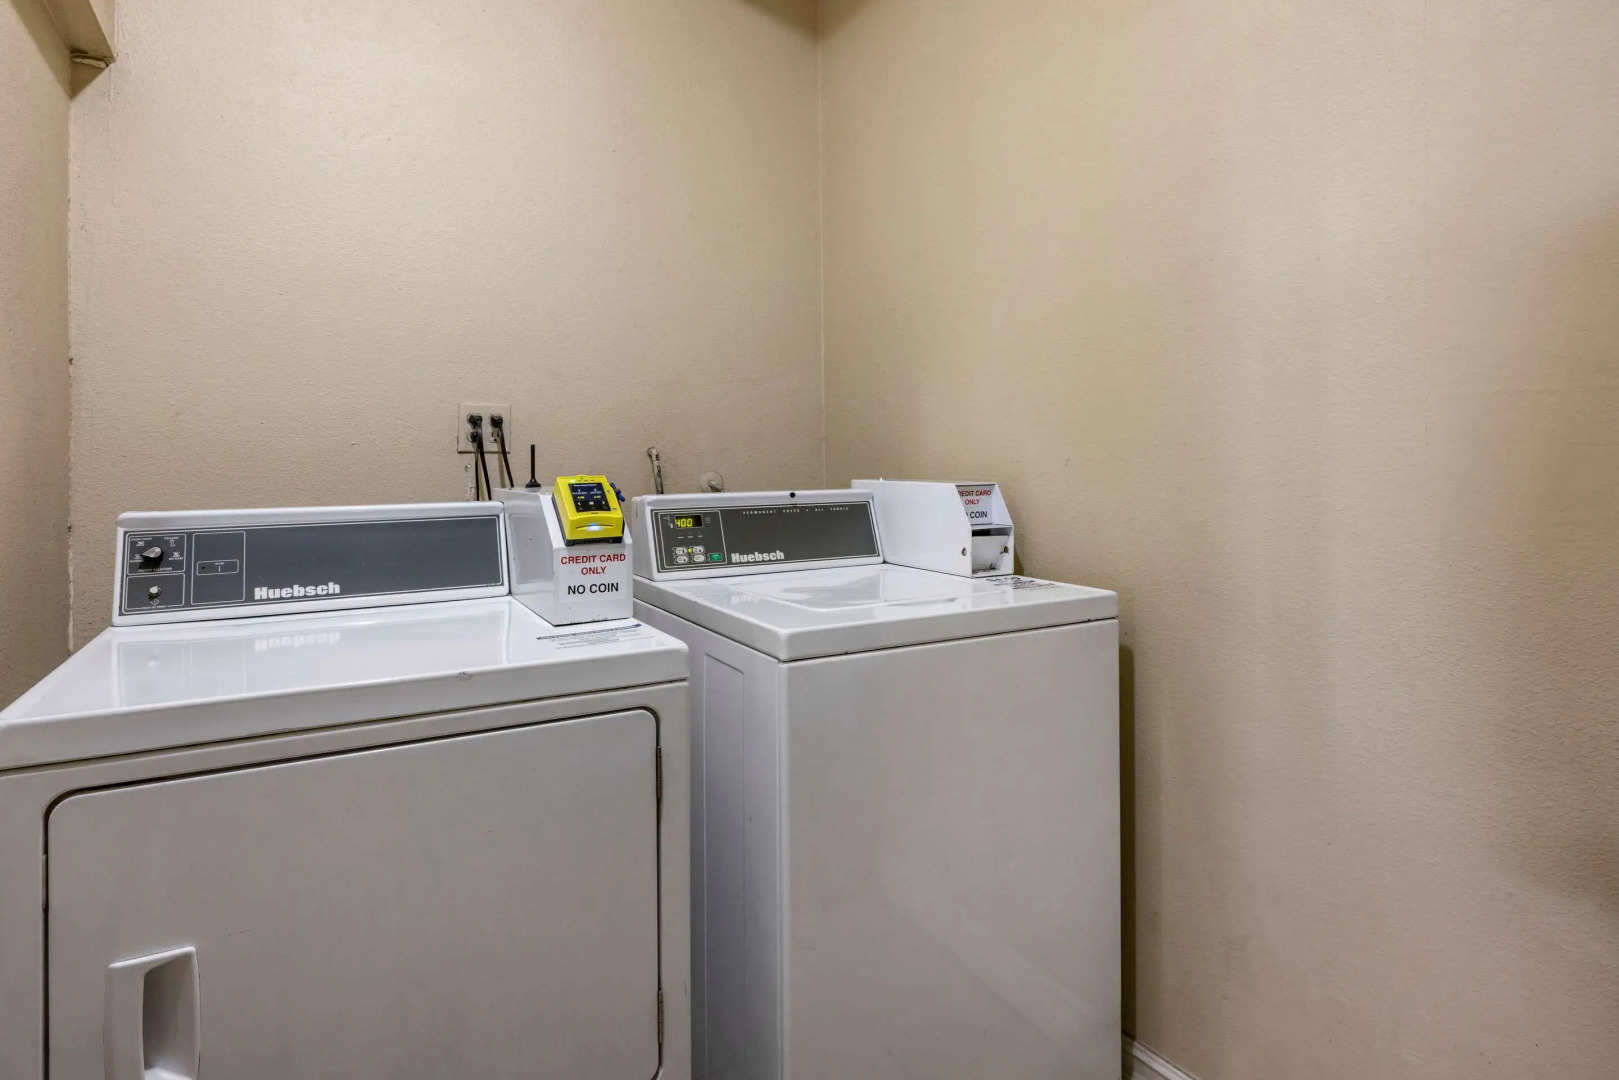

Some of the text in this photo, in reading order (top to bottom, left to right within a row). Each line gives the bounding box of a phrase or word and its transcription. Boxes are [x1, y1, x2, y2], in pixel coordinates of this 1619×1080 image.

[958, 489, 992, 498] REDIT CARD
[964, 498, 980, 506] ONLY
[969, 510, 988, 519] COIN
[675, 518, 693, 528] 400
[560, 553, 626, 565] CREDIT CARD
[730, 550, 785, 564] Huebsch
[581, 566, 606, 576] ONLY
[254, 581, 341, 600] Huebsch
[567, 582, 619, 596] NO COIN
